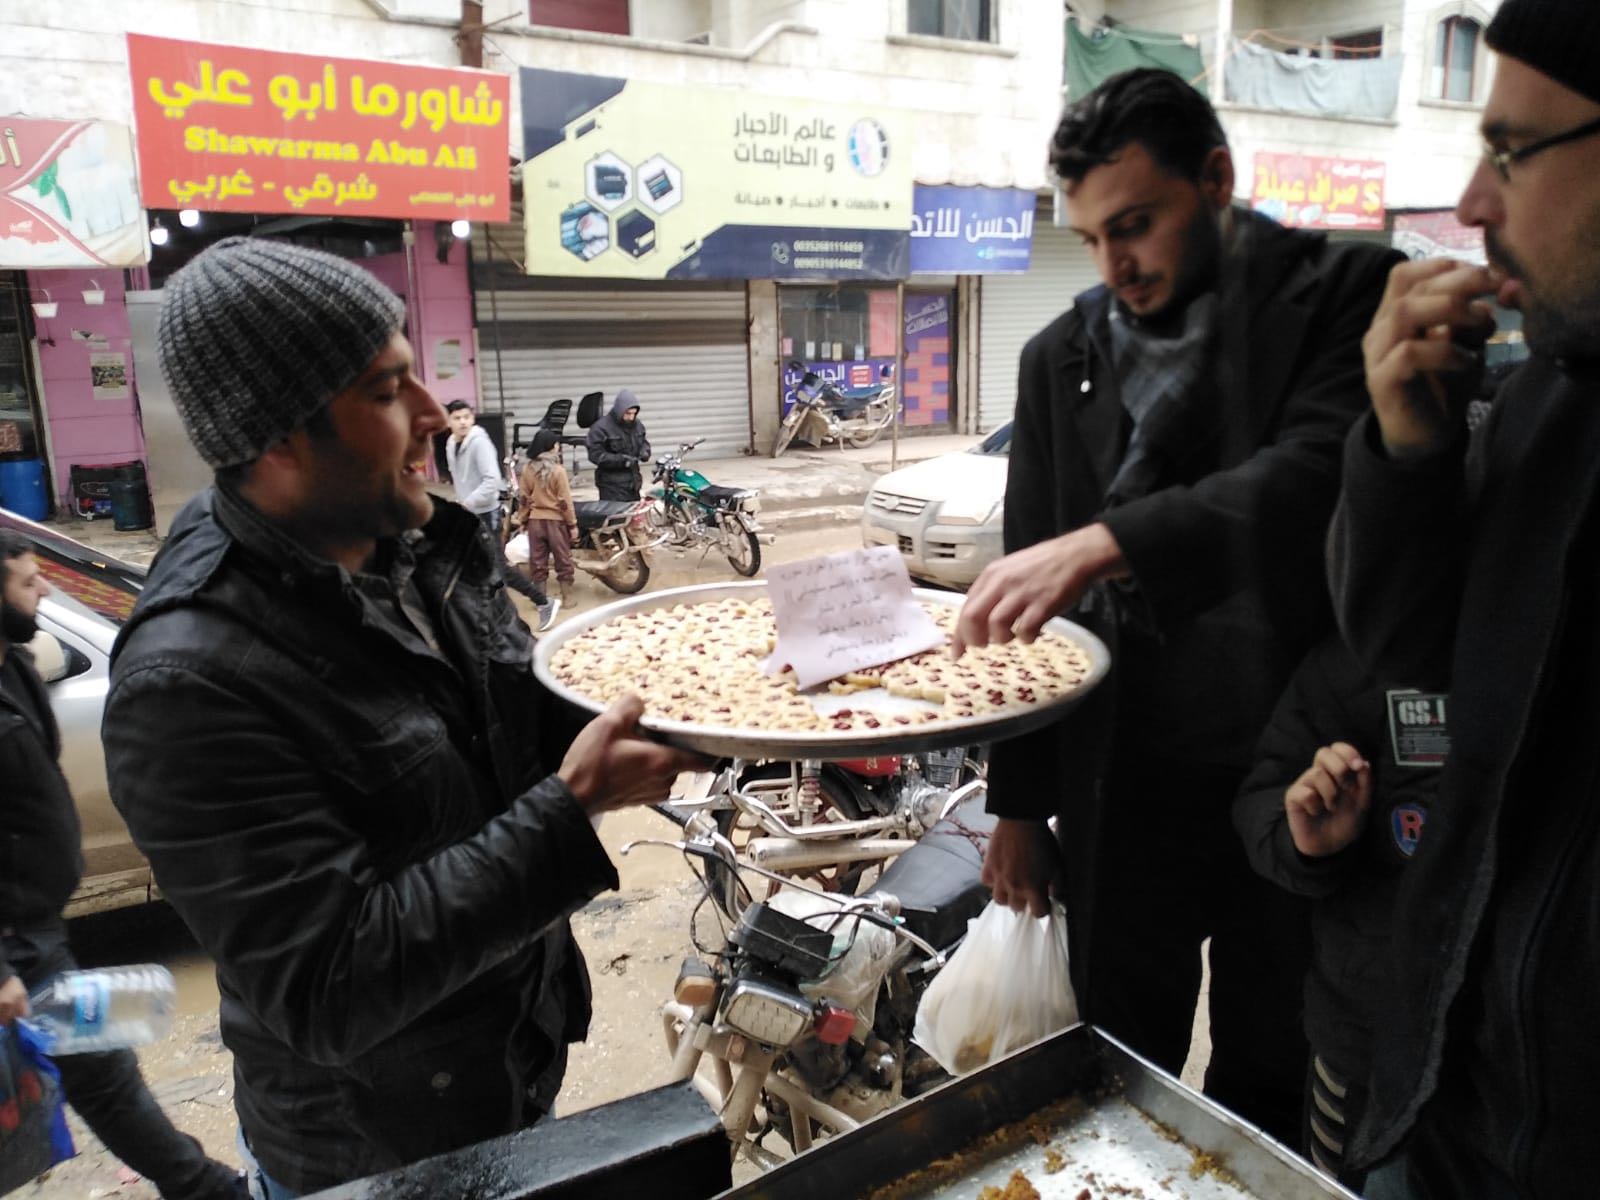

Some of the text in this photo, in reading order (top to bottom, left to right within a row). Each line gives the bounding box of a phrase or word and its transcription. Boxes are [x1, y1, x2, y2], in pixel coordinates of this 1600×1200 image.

[148, 60, 503, 133] شاورما أبو علي
[734, 111, 837, 142] عالم الأحبار
[184, 125, 477, 170] Shawarma Abu Ali
[734, 142, 835, 173] و الطابعات
[168, 169, 254, 203] غربي
[284, 171, 377, 207] شرقي
[965, 210, 1033, 243] الحسن
